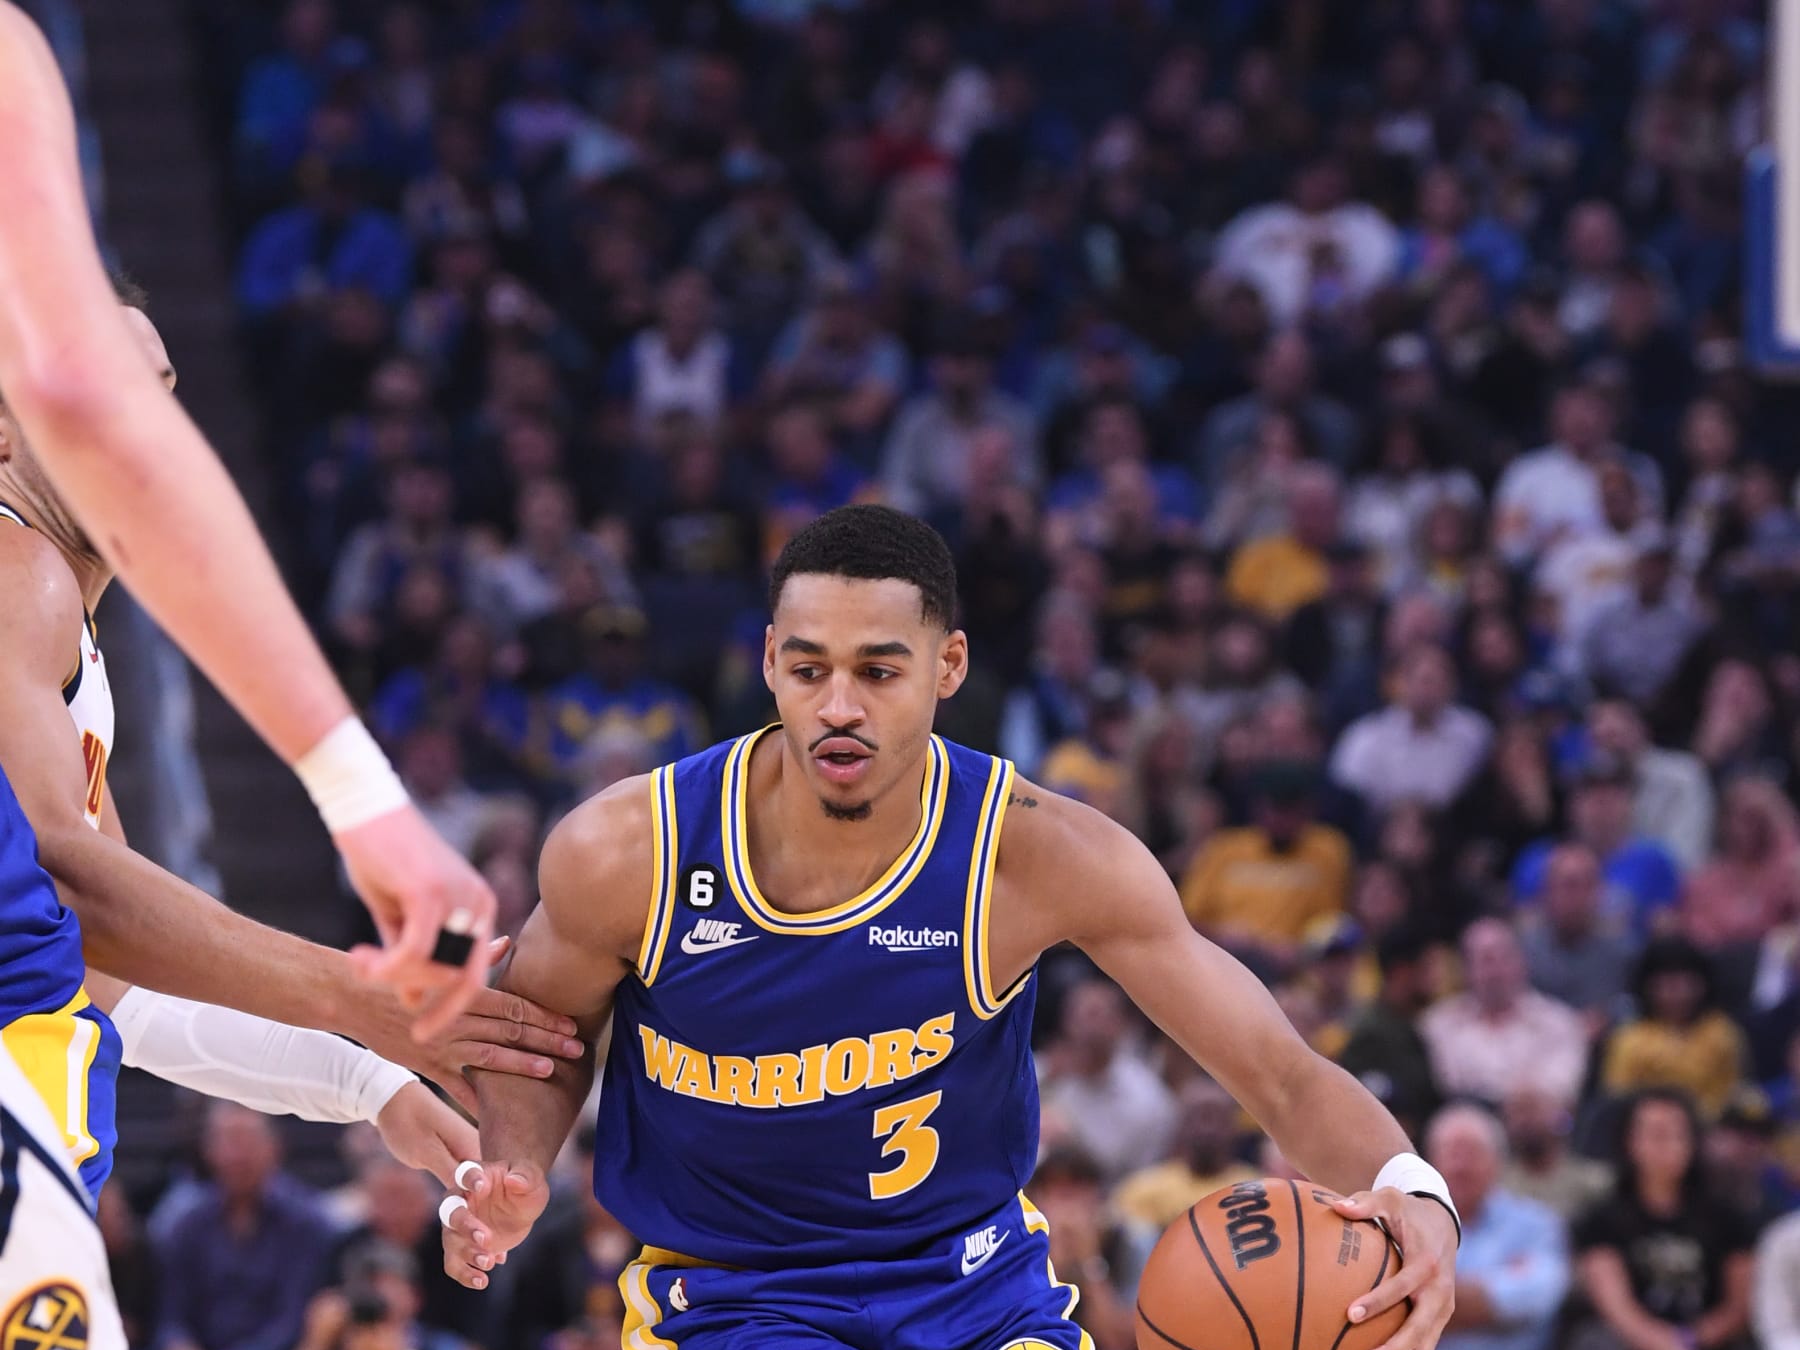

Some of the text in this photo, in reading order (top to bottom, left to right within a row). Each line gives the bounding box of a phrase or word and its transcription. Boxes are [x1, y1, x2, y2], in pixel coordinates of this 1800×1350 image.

[690, 870, 714, 906] 6
[691, 918, 742, 943] NIKE
[869, 925, 958, 947] Rakuten
[638, 1011, 956, 1109] WARRIORS
[868, 1089, 943, 1200] 3
[964, 1225, 997, 1260] NIKE
